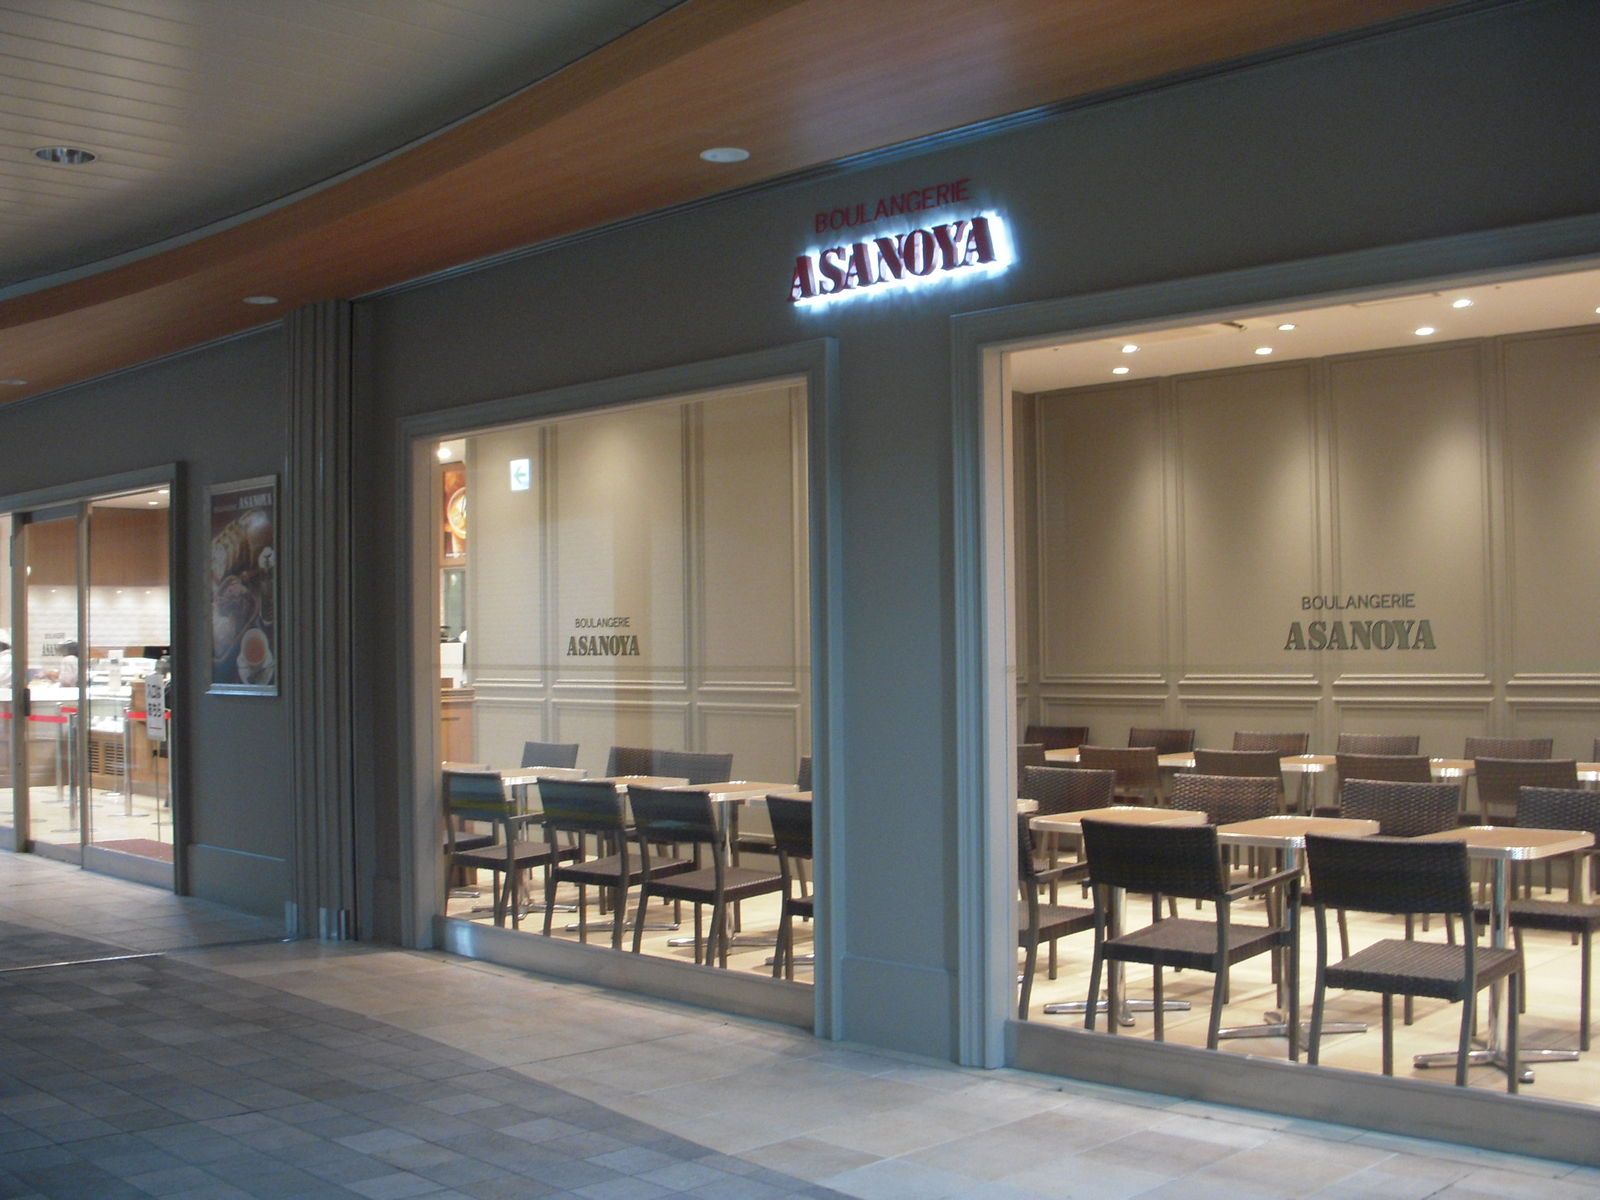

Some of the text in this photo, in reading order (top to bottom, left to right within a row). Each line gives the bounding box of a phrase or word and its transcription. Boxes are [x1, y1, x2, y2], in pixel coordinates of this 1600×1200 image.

[814, 178, 972, 234] BOULANGERIE
[788, 216, 996, 302] ASANOYA
[1302, 593, 1416, 610] BOULANGERIE
[575, 616, 630, 628] BOULANGERIE
[1283, 619, 1437, 650] ASANOYA
[566, 635, 641, 656] ASANOYA
